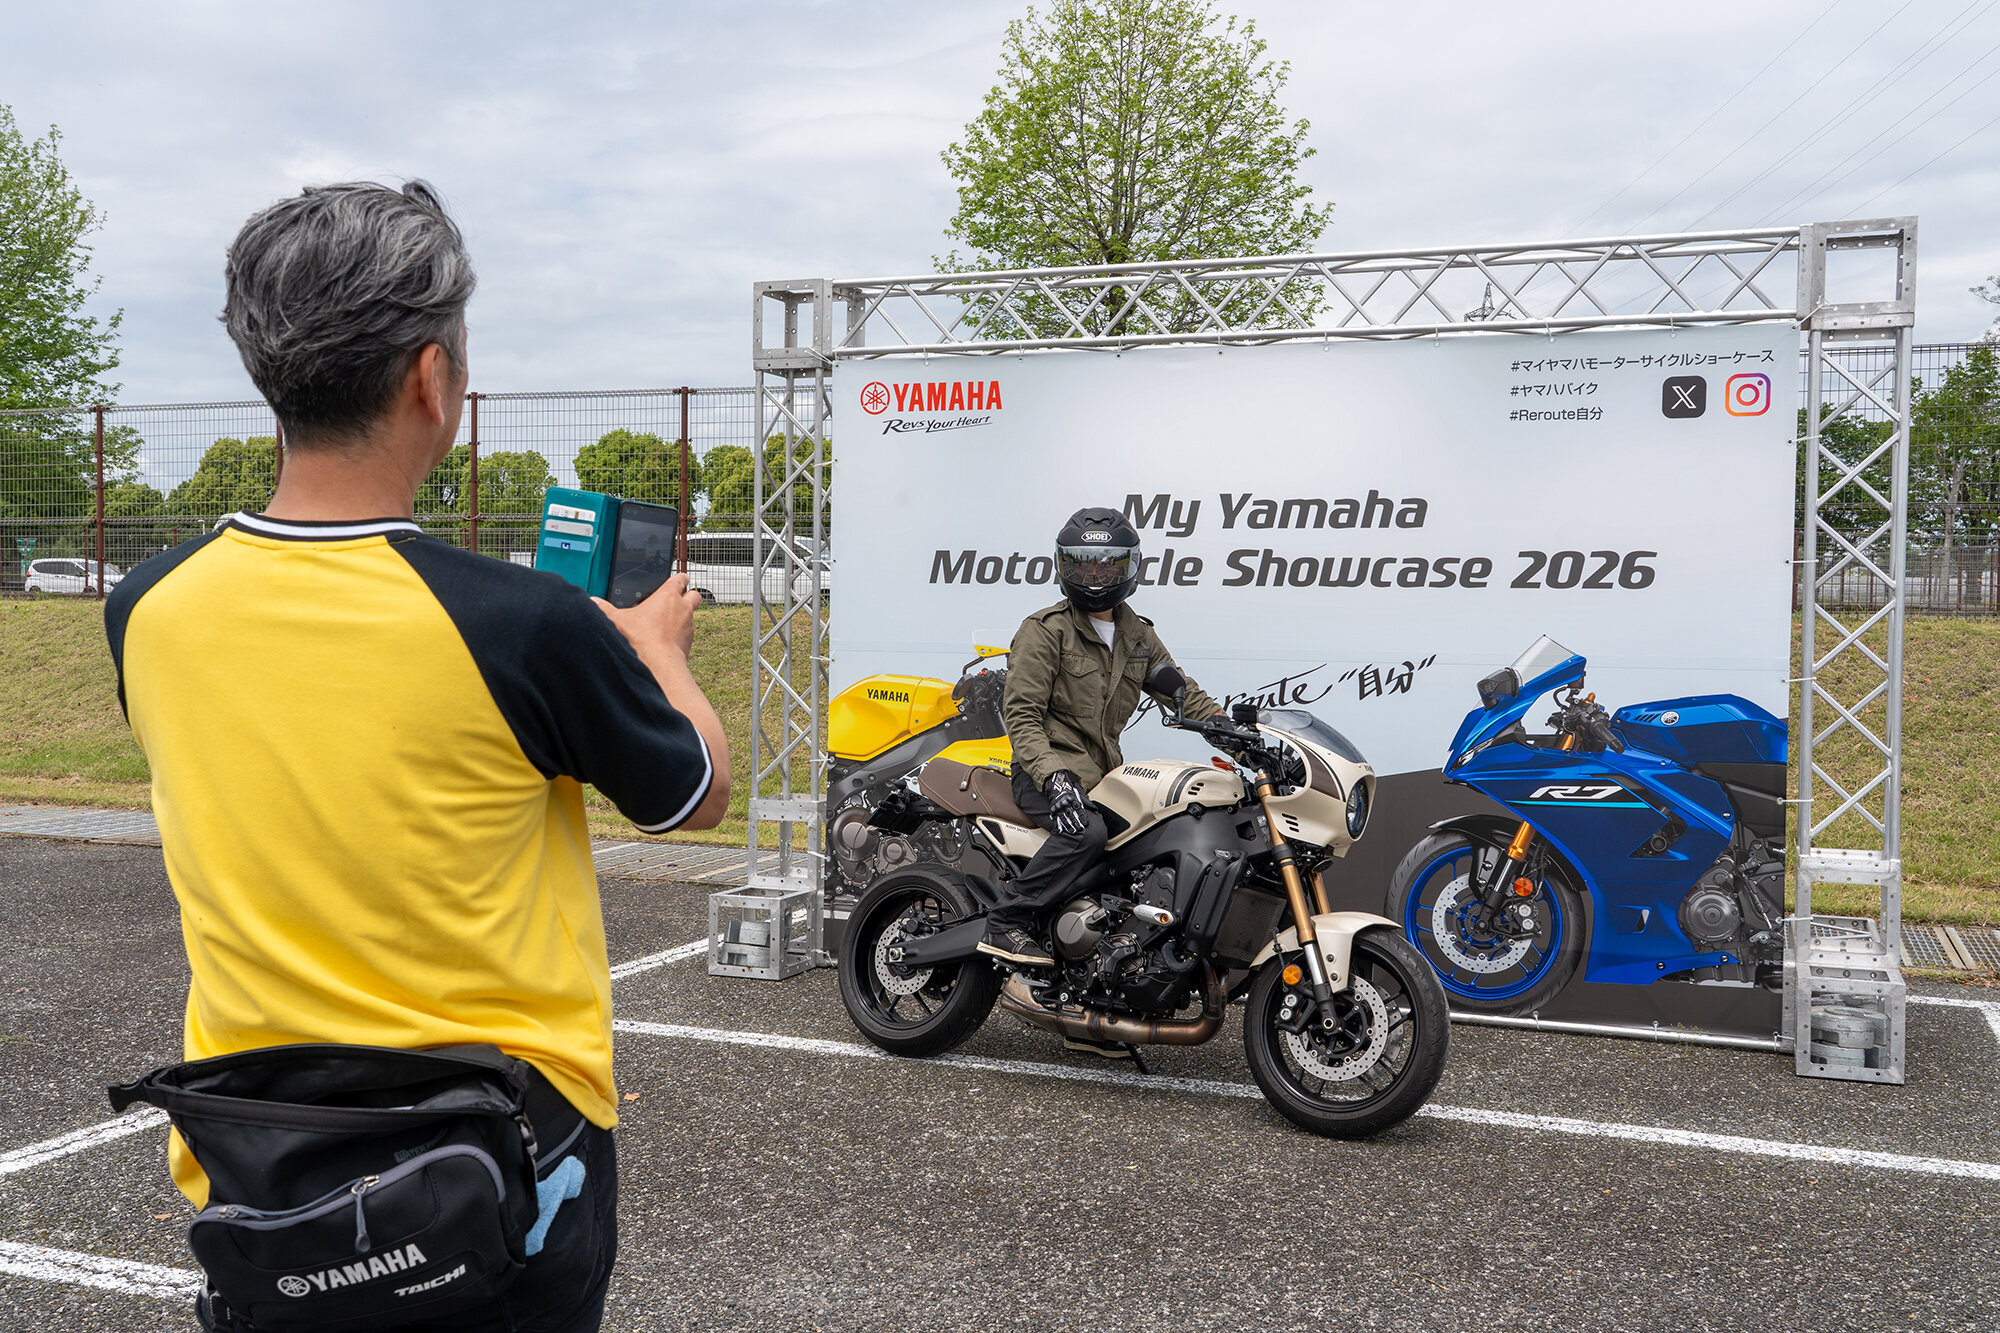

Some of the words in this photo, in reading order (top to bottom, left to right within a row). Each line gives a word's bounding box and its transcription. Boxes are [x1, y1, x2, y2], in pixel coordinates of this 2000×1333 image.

[1511, 349, 1775, 372] #マイヤマハモーターサイクルショーケース
[893, 380, 1003, 413] YAMAHA
[1510, 382, 1599, 398] #ヤマハバイク
[1509, 406, 1604, 422] #Reroute自分
[882, 418, 926, 436] Revs
[925, 418, 957, 433] Your
[957, 415, 991, 427] Heart
[1122, 493, 1203, 538] My
[1219, 489, 1428, 530] Yamaha
[928, 549, 1204, 587] Motocle
[1221, 548, 1493, 589] Showcase
[1509, 550, 1659, 590] 2026
[867, 688, 910, 703] YAMAHA
[1121, 765, 1161, 781] YAMAHA
[1529, 785, 1623, 800] R7
[306, 1243, 427, 1292] YAMAHA
[393, 1263, 467, 1297] TAICHI
